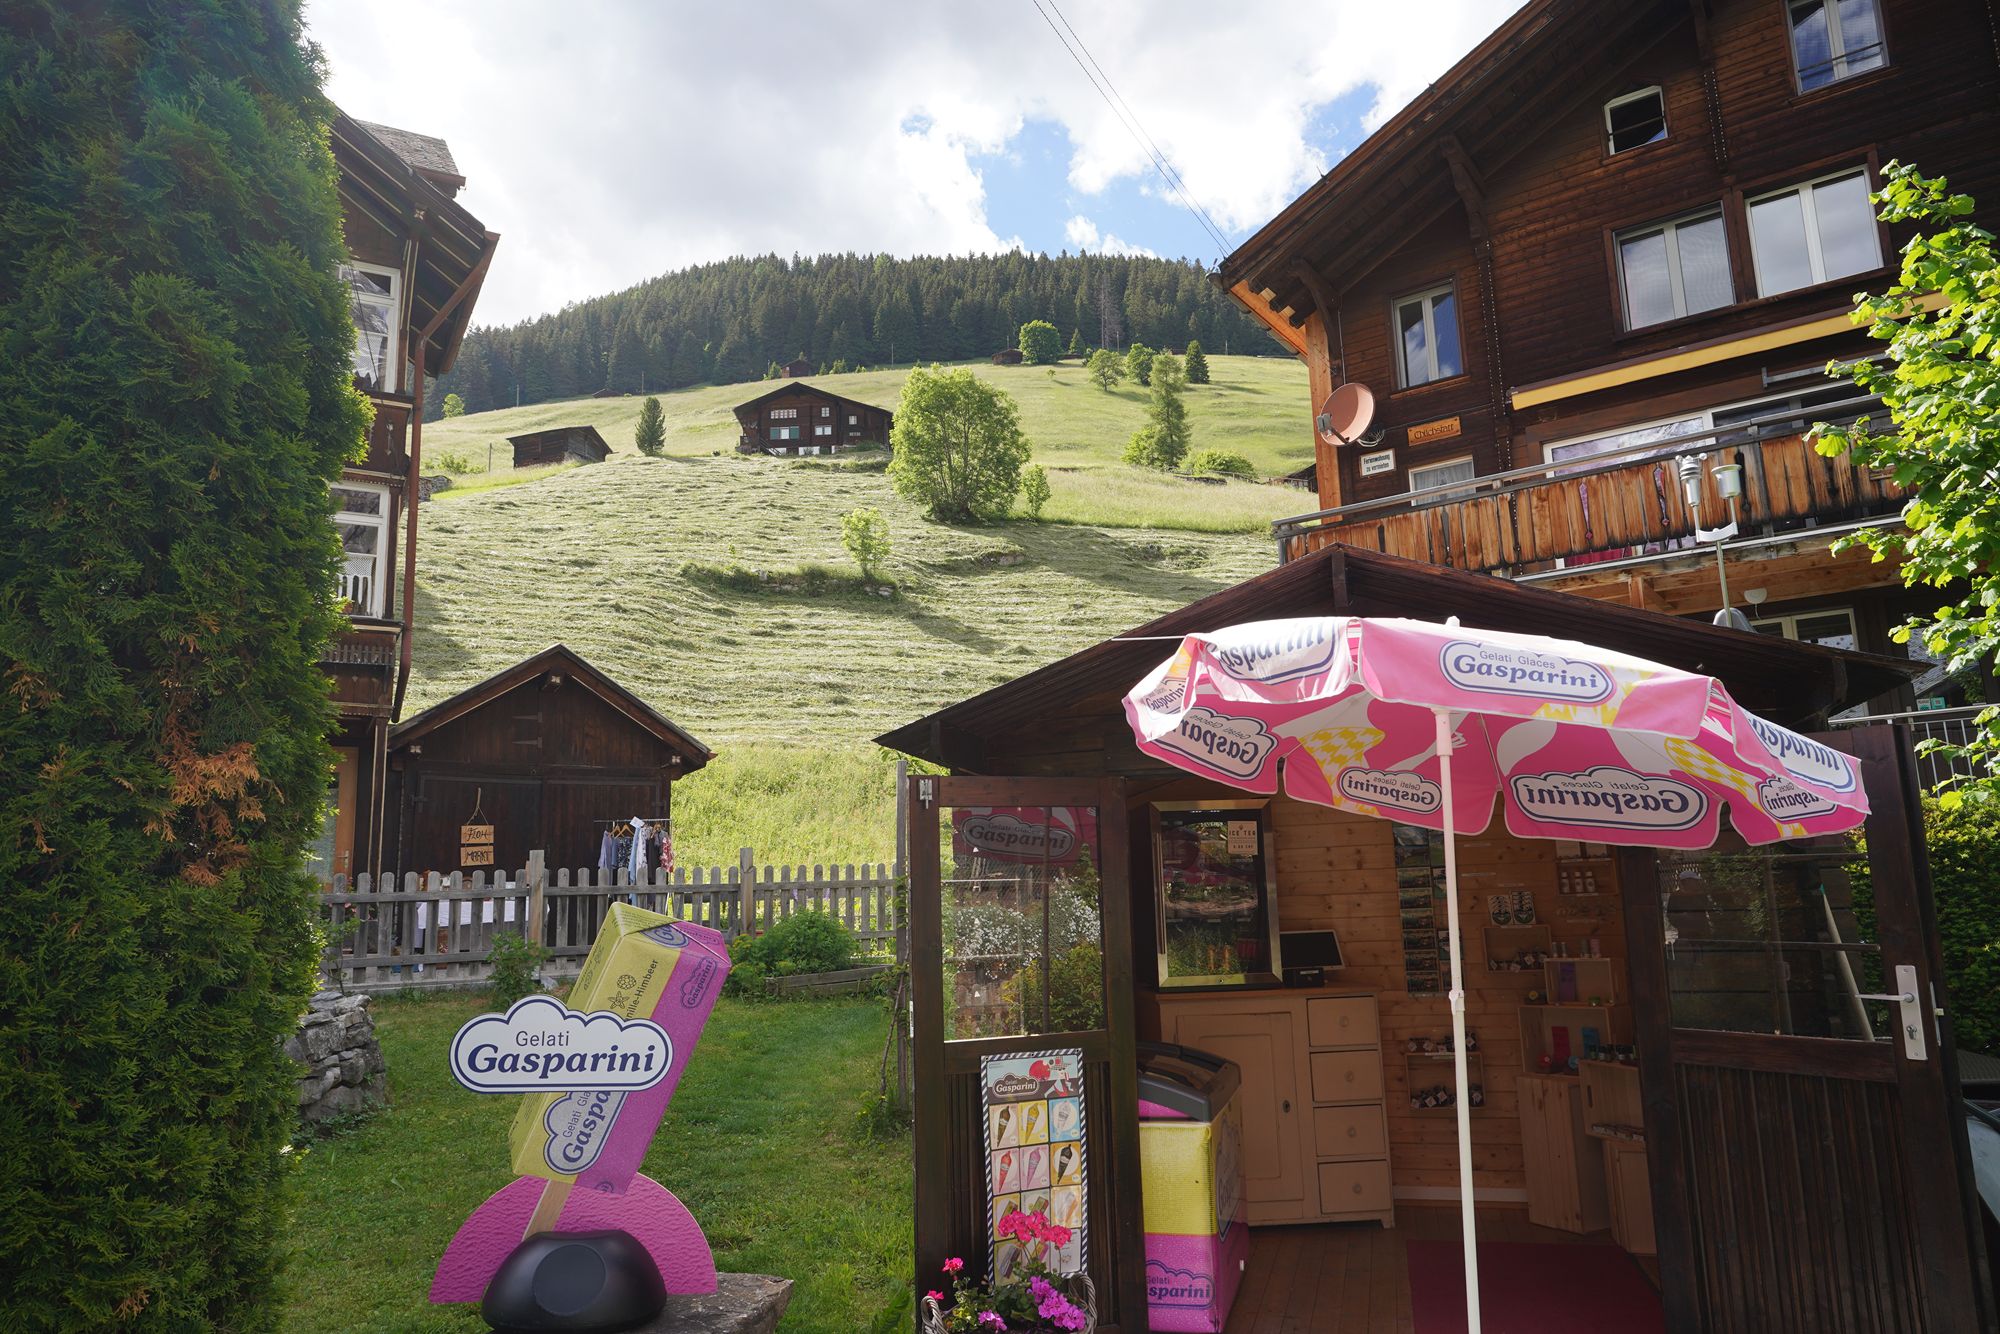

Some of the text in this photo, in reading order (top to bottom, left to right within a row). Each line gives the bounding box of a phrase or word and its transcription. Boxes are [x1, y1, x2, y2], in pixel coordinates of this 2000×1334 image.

[1453, 654, 1599, 688] Gasparini
[1479, 651, 1556, 669] Gelati Glaces
[969, 824, 1066, 850] Gasparini
[625, 960, 659, 1019] nille-Himbeer
[515, 1030, 570, 1047] Gelati
[467, 1043, 656, 1079] Gasparini
[996, 1081, 1036, 1093] Gasparini
[562, 1091, 592, 1138] Gelati Gla
[562, 1091, 611, 1163] Gaspa
[1148, 1284, 1211, 1300] sparini
